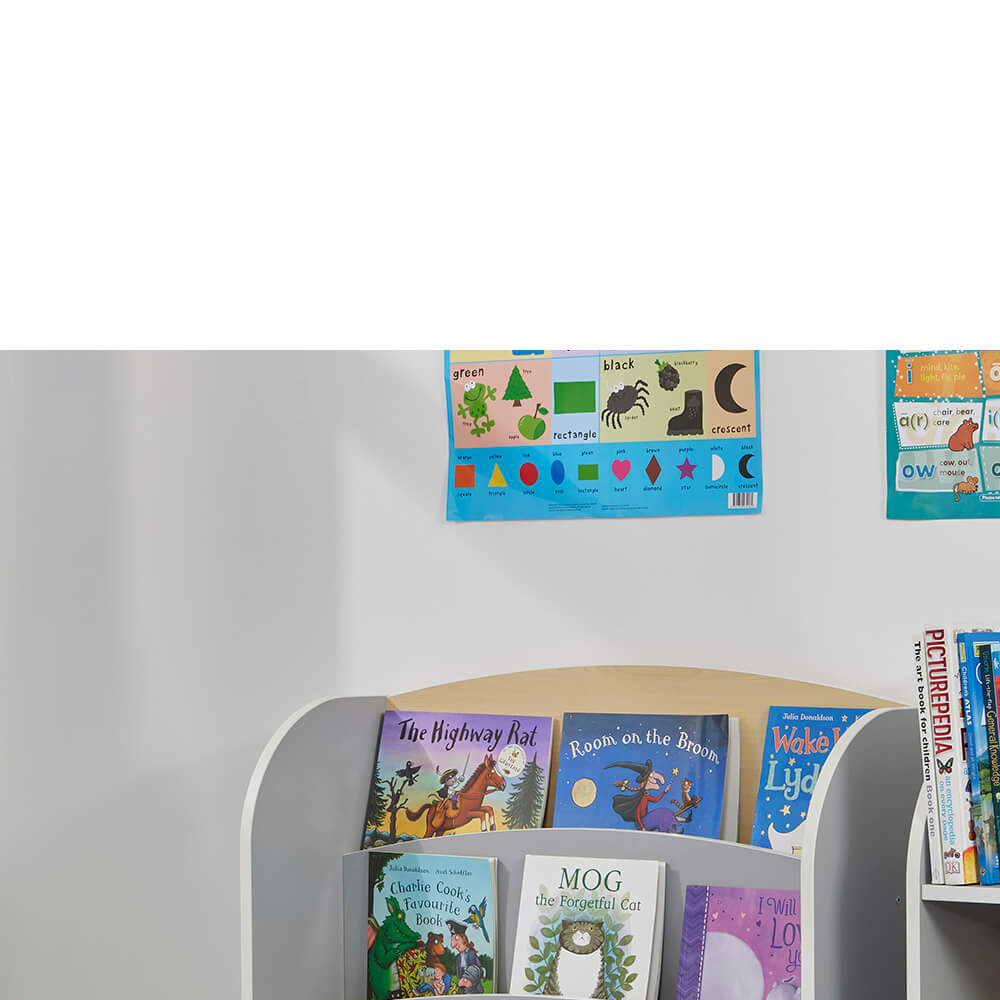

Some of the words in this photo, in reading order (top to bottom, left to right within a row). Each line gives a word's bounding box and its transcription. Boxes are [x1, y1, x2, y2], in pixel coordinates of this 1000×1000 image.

[453, 368, 485, 380] green
[604, 358, 635, 370] black
[553, 430, 597, 440] rectangle
[711, 424, 751, 434] crescent
[902, 464, 935, 478] ow
[925, 629, 952, 755] PICTUREPEDIA
[399, 718, 427, 742] The
[432, 720, 502, 752] Highway
[507, 720, 537, 747] Rat
[986, 710, 997, 745] General
[568, 734, 617, 759] Room
[622, 732, 642, 745] on
[646, 729, 671, 746] the
[676, 731, 720, 765] Broom
[772, 726, 829, 755] Wake
[921, 736, 931, 781] children
[926, 785, 934, 810] Book
[989, 746, 1000, 786] Knowledge
[764, 760, 820, 800] Lyd
[390, 879, 431, 894] Charlie
[437, 881, 472, 903] Cook's
[558, 867, 623, 892] MOG
[403, 897, 461, 916] Favourite
[535, 894, 554, 906] the
[560, 895, 615, 910] Forgetful
[621, 898, 642, 912] Cat
[758, 897, 764, 914] I
[767, 897, 797, 916] Will
[416, 914, 443, 926] Book
